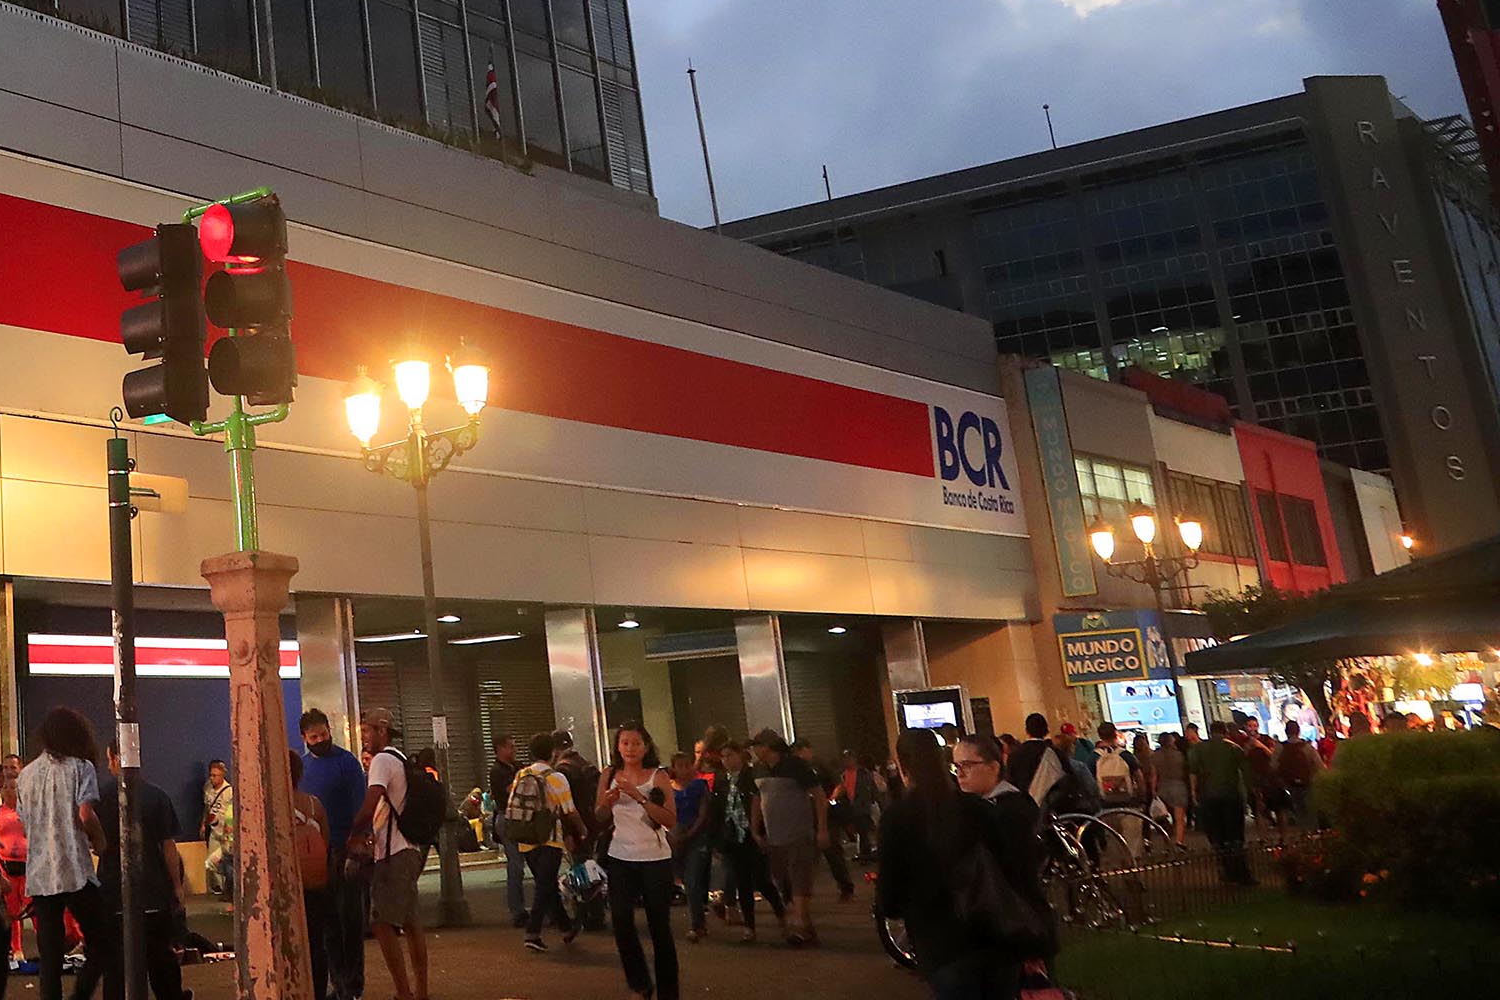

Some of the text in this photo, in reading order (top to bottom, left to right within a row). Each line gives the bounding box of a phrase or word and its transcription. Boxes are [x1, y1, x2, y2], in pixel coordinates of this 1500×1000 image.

[1356, 120, 1466, 481] RAVENTOS
[934, 406, 1010, 490] BCR
[943, 485, 1014, 514] Banco de Costa Rica
[1067, 638, 1134, 656] MUNDO
